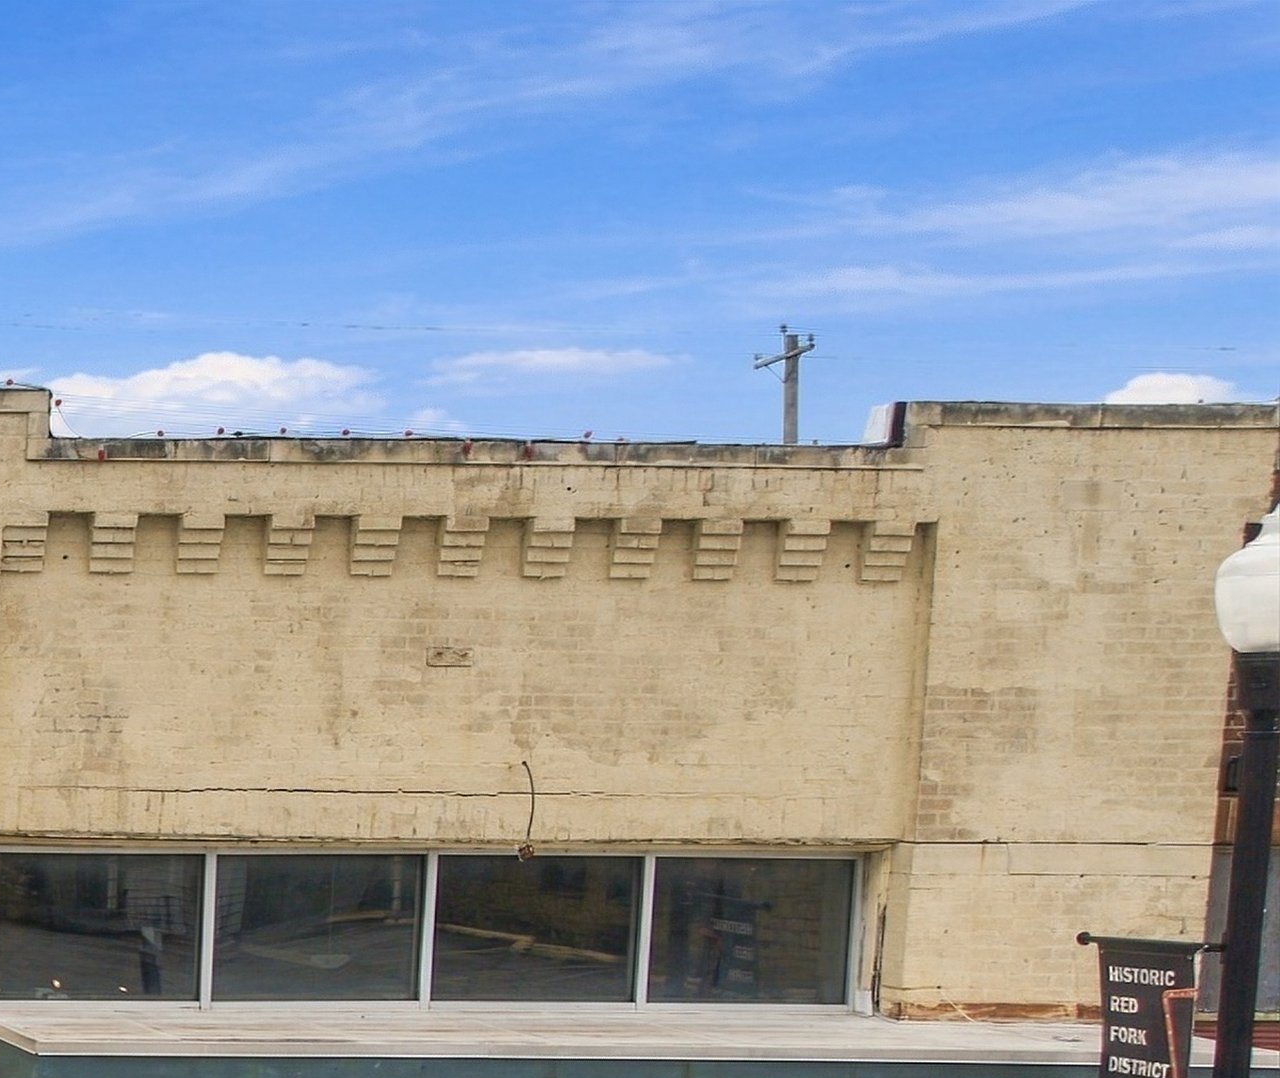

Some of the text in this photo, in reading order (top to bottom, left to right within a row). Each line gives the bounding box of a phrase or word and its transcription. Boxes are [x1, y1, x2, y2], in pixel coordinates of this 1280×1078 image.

[1108, 965, 1176, 987] HISTORIC
[1110, 995, 1138, 1014] RED
[1110, 1026, 1147, 1046] FORK
